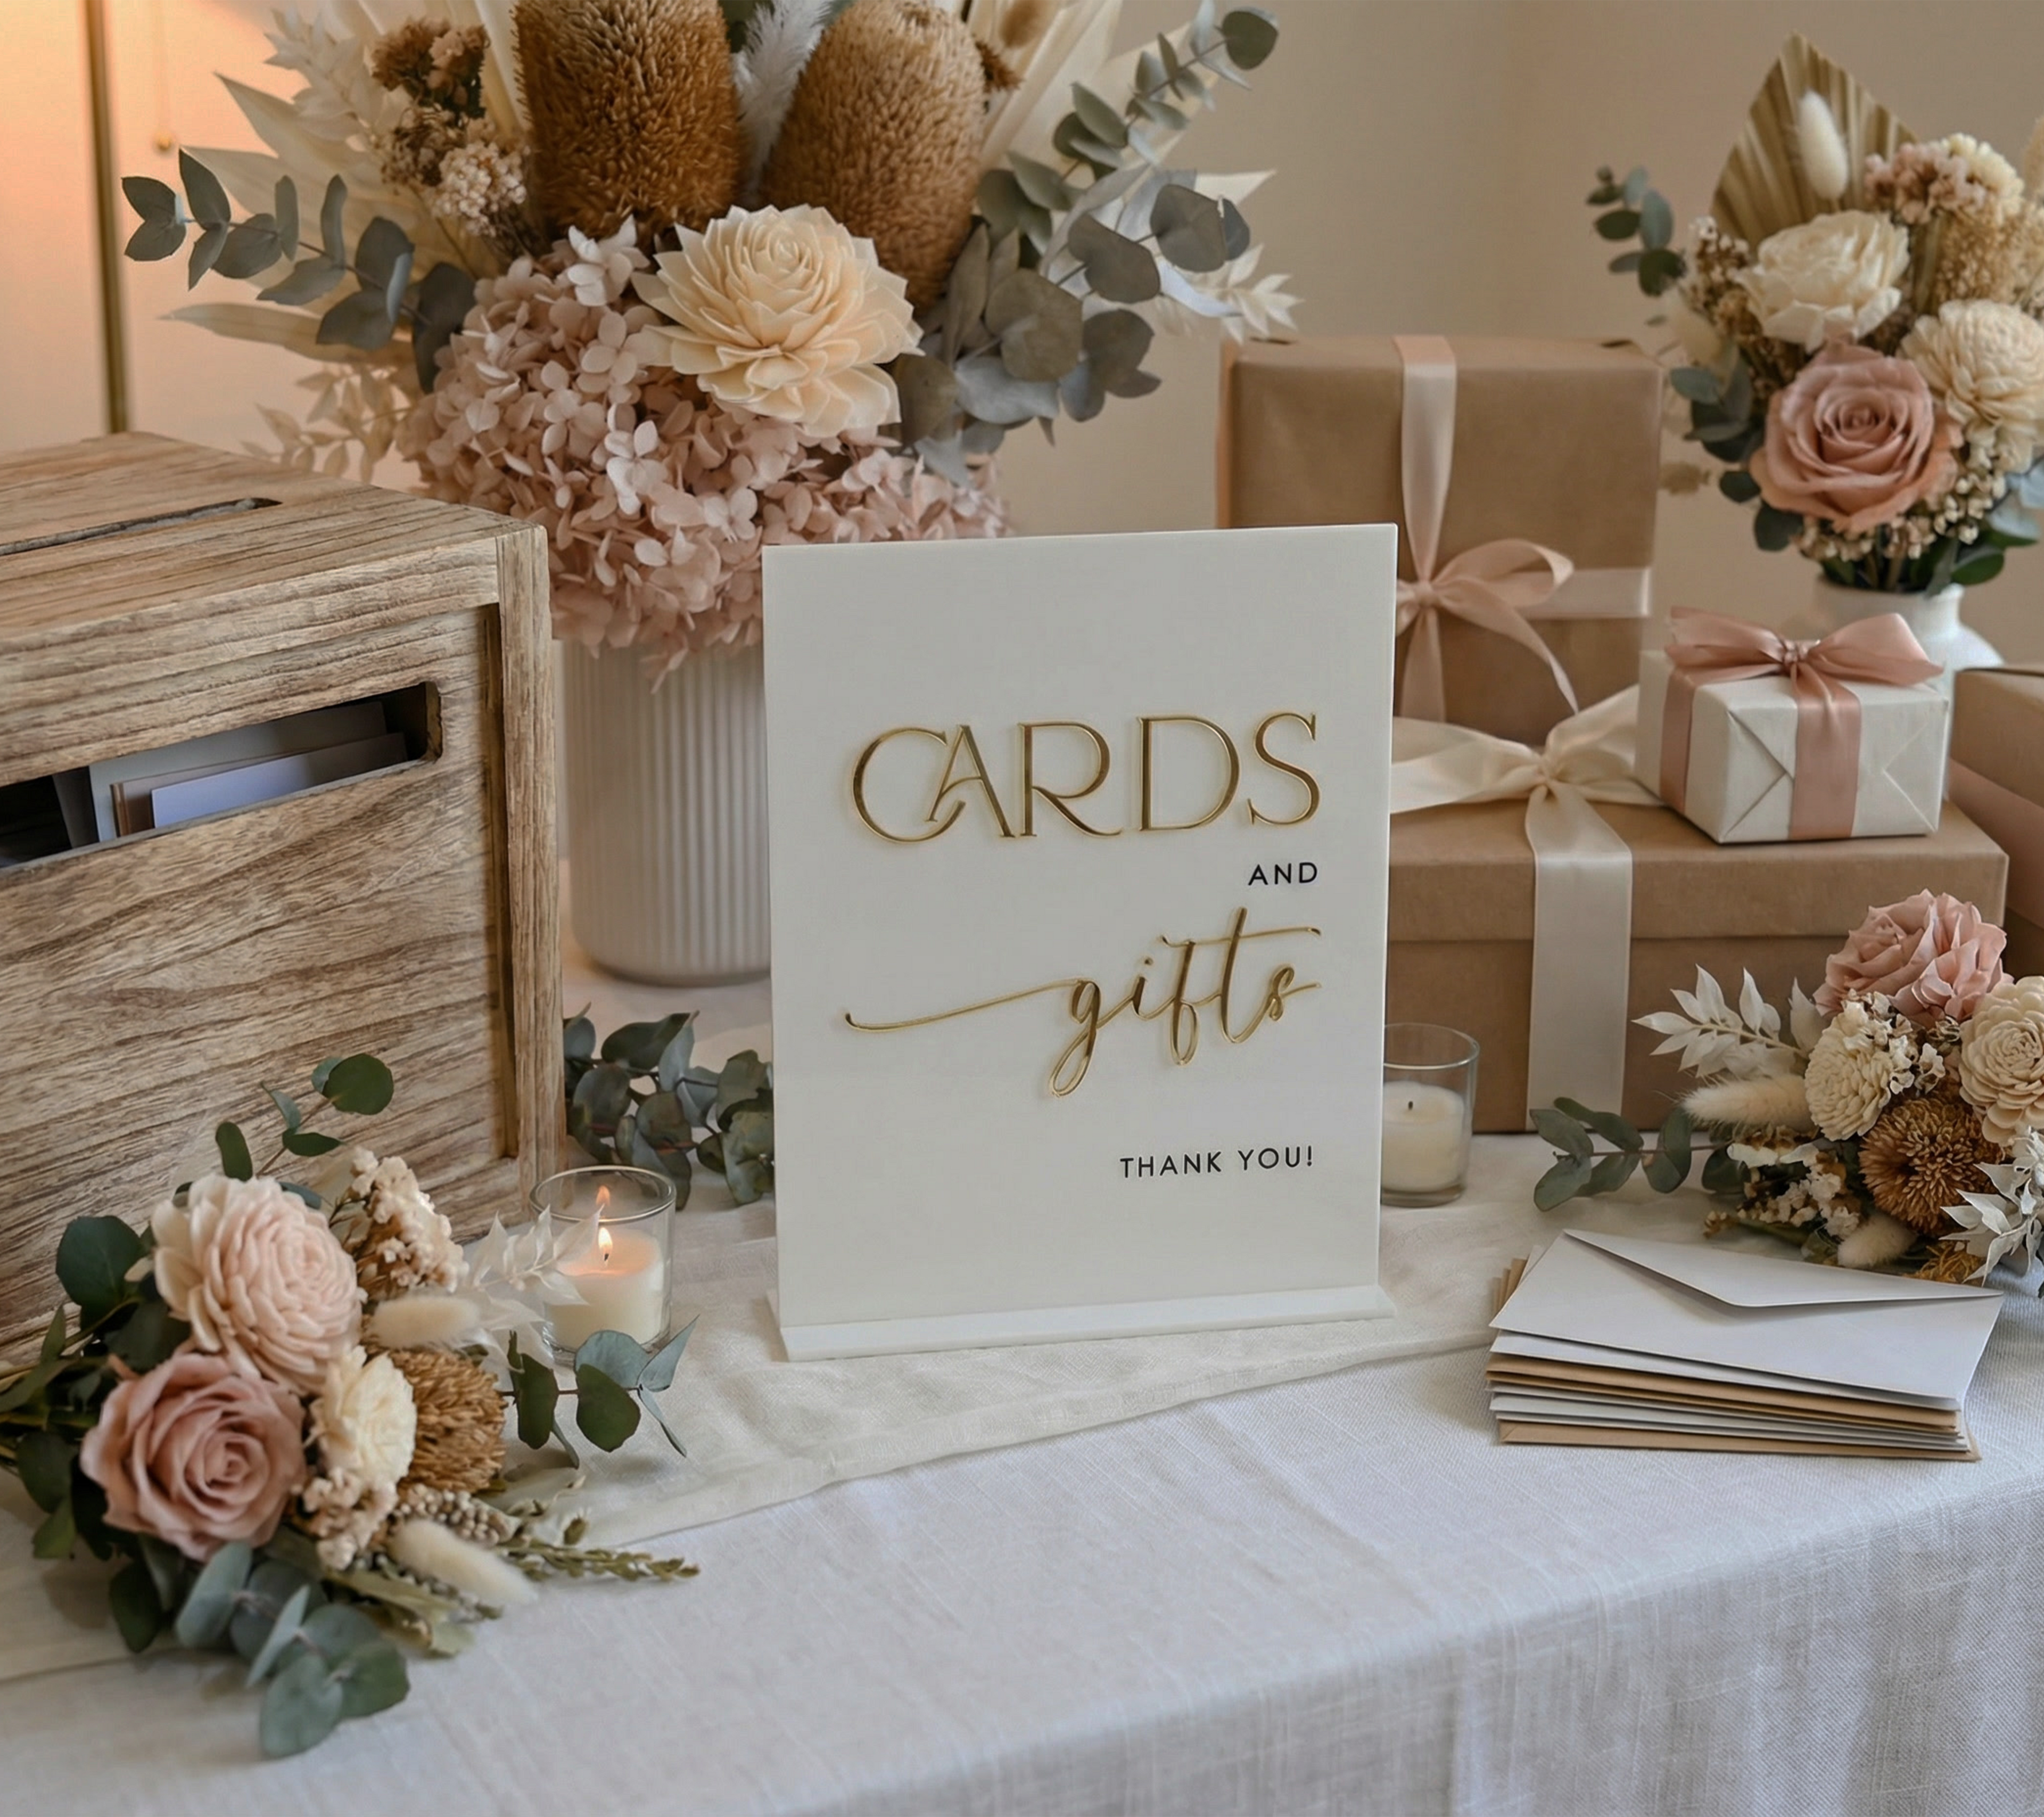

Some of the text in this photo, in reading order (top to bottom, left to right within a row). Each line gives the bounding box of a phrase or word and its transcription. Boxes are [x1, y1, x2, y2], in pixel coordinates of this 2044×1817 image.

[852, 712, 1320, 842] CARDS
[1248, 861, 1318, 886] AND
[845, 907, 1321, 1097] gifts
[1119, 1146, 1312, 1178] THANK YOU!
